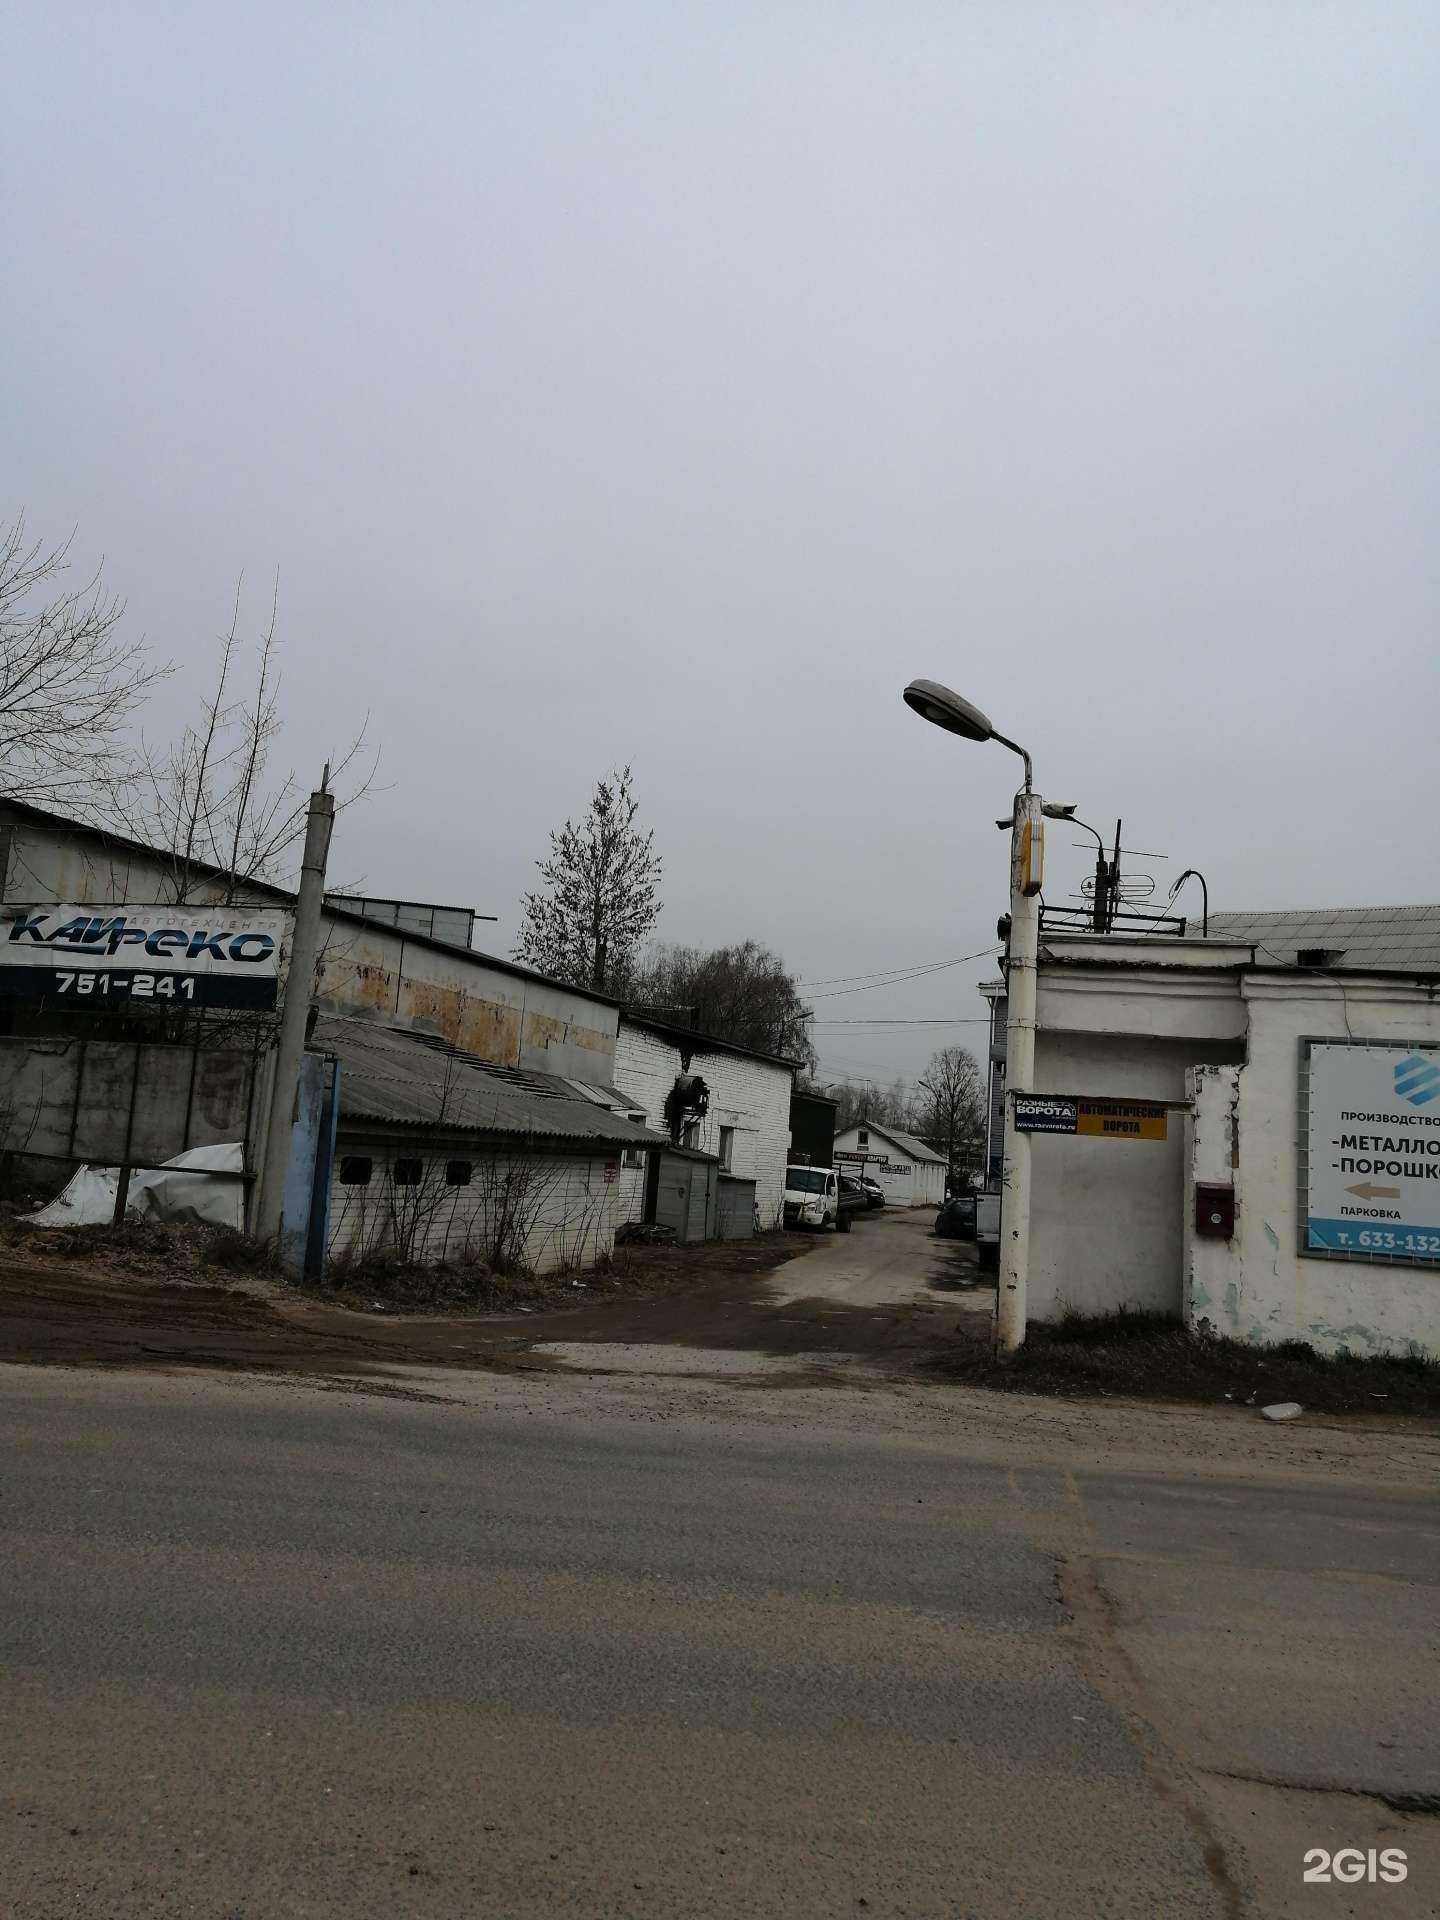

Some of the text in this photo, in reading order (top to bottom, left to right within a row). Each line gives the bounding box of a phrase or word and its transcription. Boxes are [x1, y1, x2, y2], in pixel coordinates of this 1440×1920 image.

[55, 973, 196, 1000] 751-241
[1016, 1099, 1056, 1108] РАЗНЫЕ
[1016, 1106, 1072, 1117] ВОРОТА
[1341, 1111, 1440, 1126] ПРОИЗВОДСТВО
[1104, 1120, 1140, 1133] ВОРОТА
[1341, 1206, 1402, 1219] ПАРКОВКА
